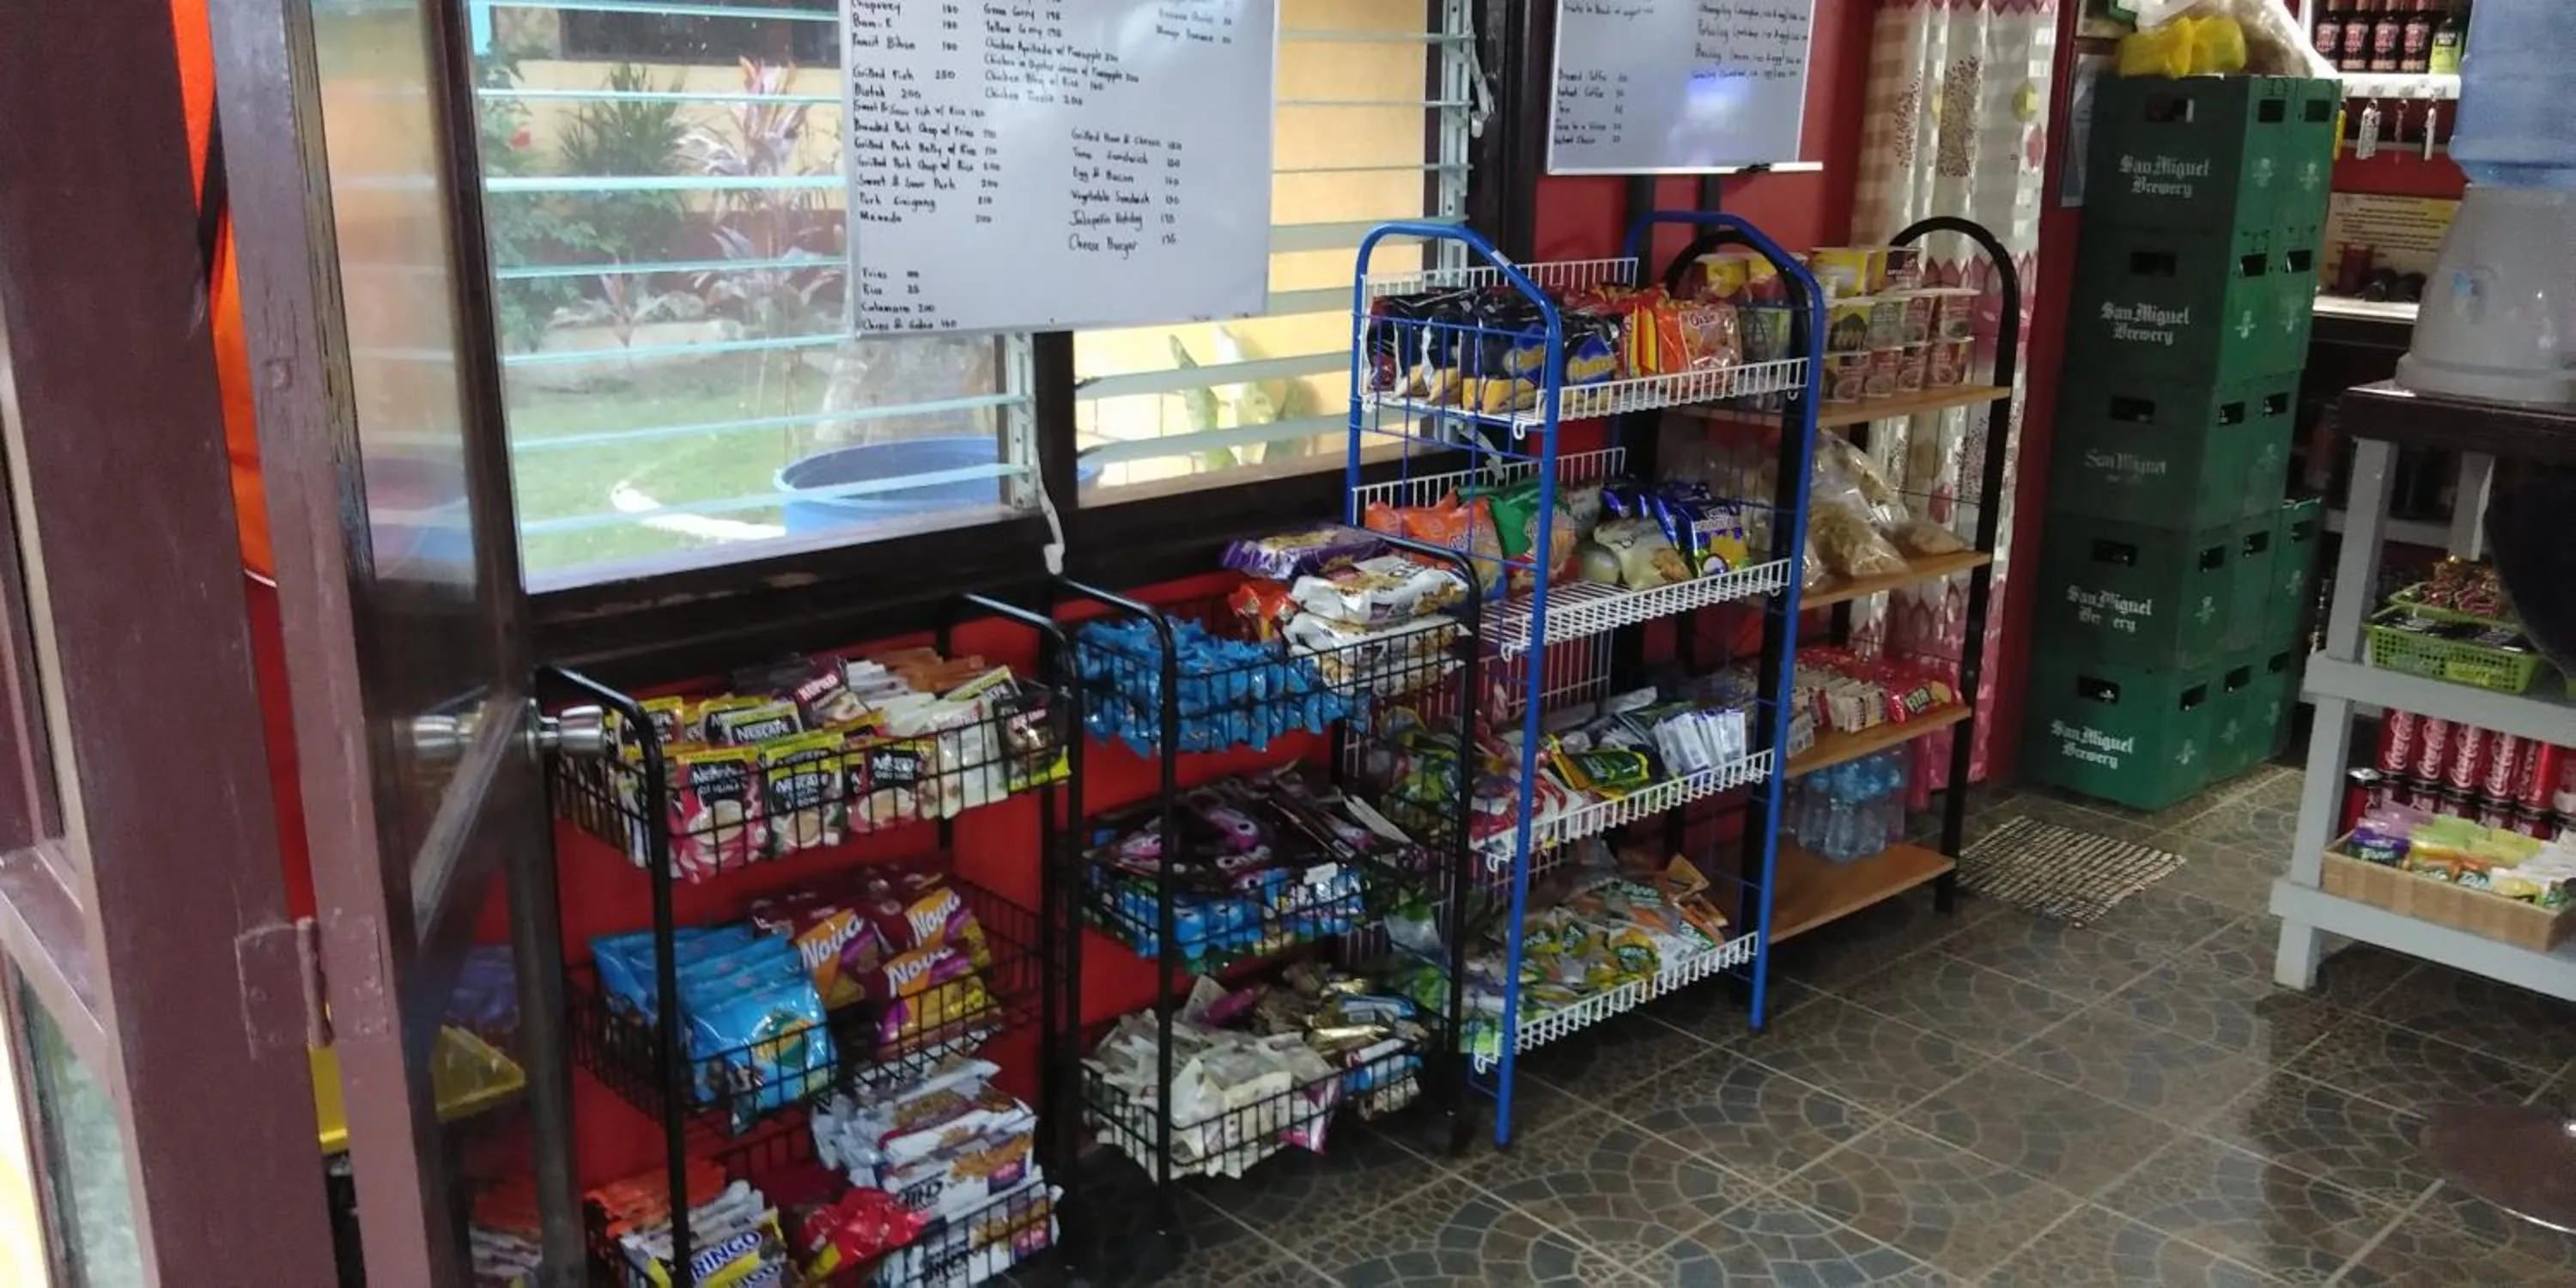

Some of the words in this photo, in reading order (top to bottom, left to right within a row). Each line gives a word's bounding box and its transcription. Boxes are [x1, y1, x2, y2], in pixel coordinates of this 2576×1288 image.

[2119, 155, 2152, 174] San
[2152, 155, 2210, 179] Miguel
[2131, 176, 2193, 198] Brewery
[2100, 301, 2133, 322] San
[2133, 303, 2190, 325] Miguel
[2113, 323, 2174, 345] Brewery
[2050, 720, 2081, 743] San
[2081, 725, 2135, 753] Miguel
[2062, 741, 2119, 769] Brewery
[912, 891, 962, 948] Nova
[799, 917, 863, 969] Nova
[690, 1231, 762, 1285] BINGO
